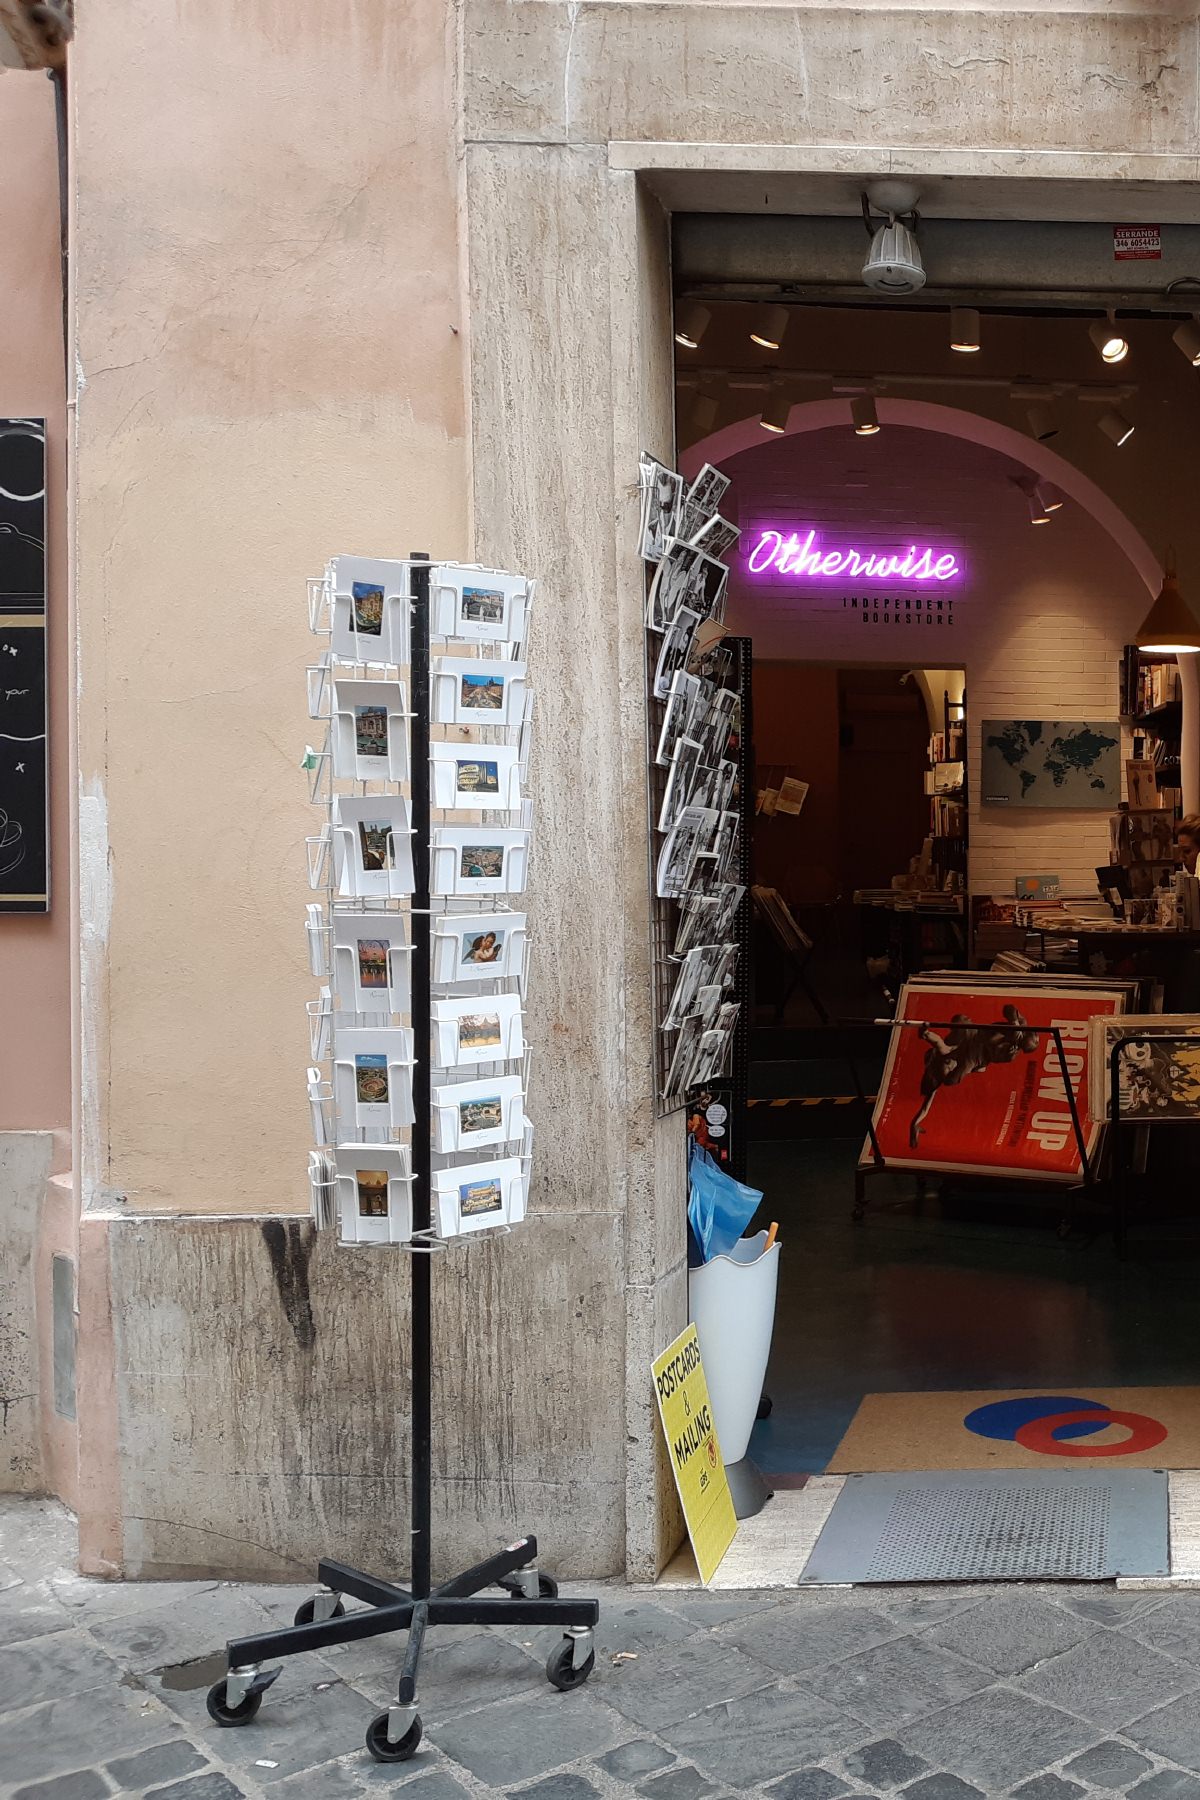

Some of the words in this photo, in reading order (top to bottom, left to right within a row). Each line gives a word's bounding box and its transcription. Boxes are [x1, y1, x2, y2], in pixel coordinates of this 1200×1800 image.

[1116, 230, 1159, 238] SERRANDE
[747, 530, 959, 581] Otherwise
[842, 596, 955, 612] INDEPENDENT
[862, 612, 955, 625] BOOKSTORE
[1026, 1111, 1075, 1153] UP
[657, 1337, 701, 1405] POSTCARDS
[683, 1390, 691, 1417] &
[674, 1404, 711, 1470] MAILING
